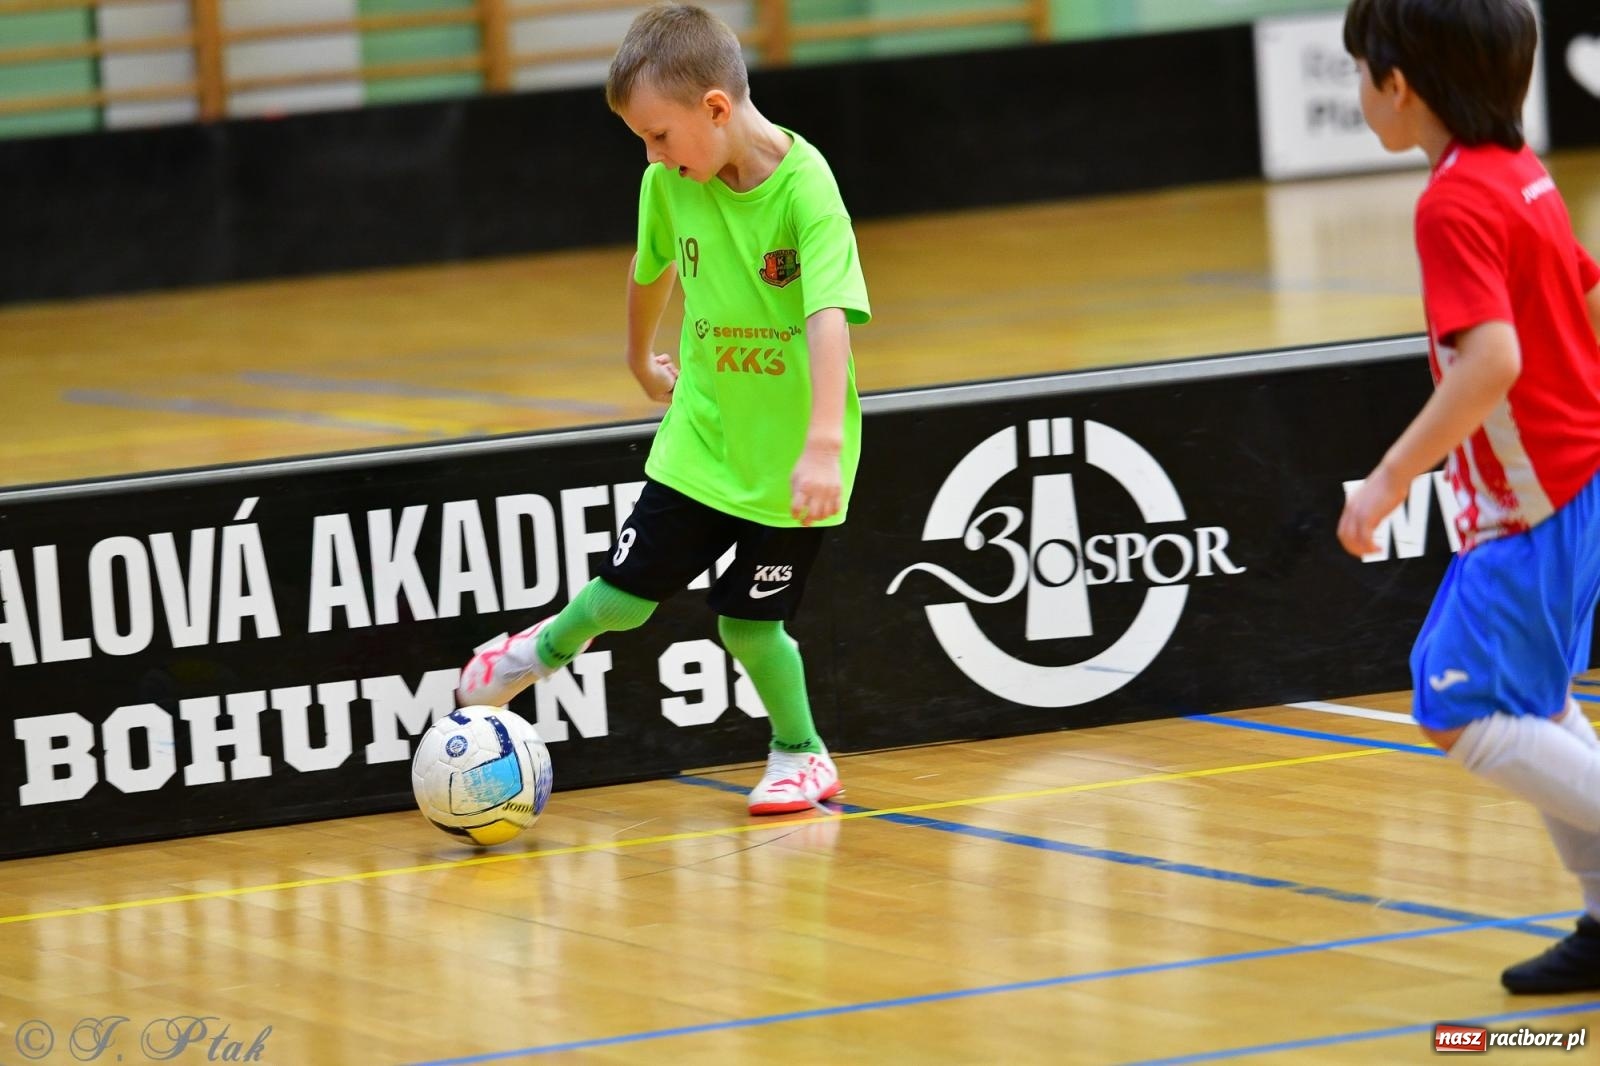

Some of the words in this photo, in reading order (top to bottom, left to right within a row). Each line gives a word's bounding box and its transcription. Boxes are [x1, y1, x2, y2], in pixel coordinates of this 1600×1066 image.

[679, 237, 699, 277] 19
[716, 346, 786, 376] KKS
[613, 528, 637, 567] 8
[0, 496, 282, 667] ALOVÁ
[753, 565, 793, 582] KKS
[14, 632, 613, 807] BOHUMN
